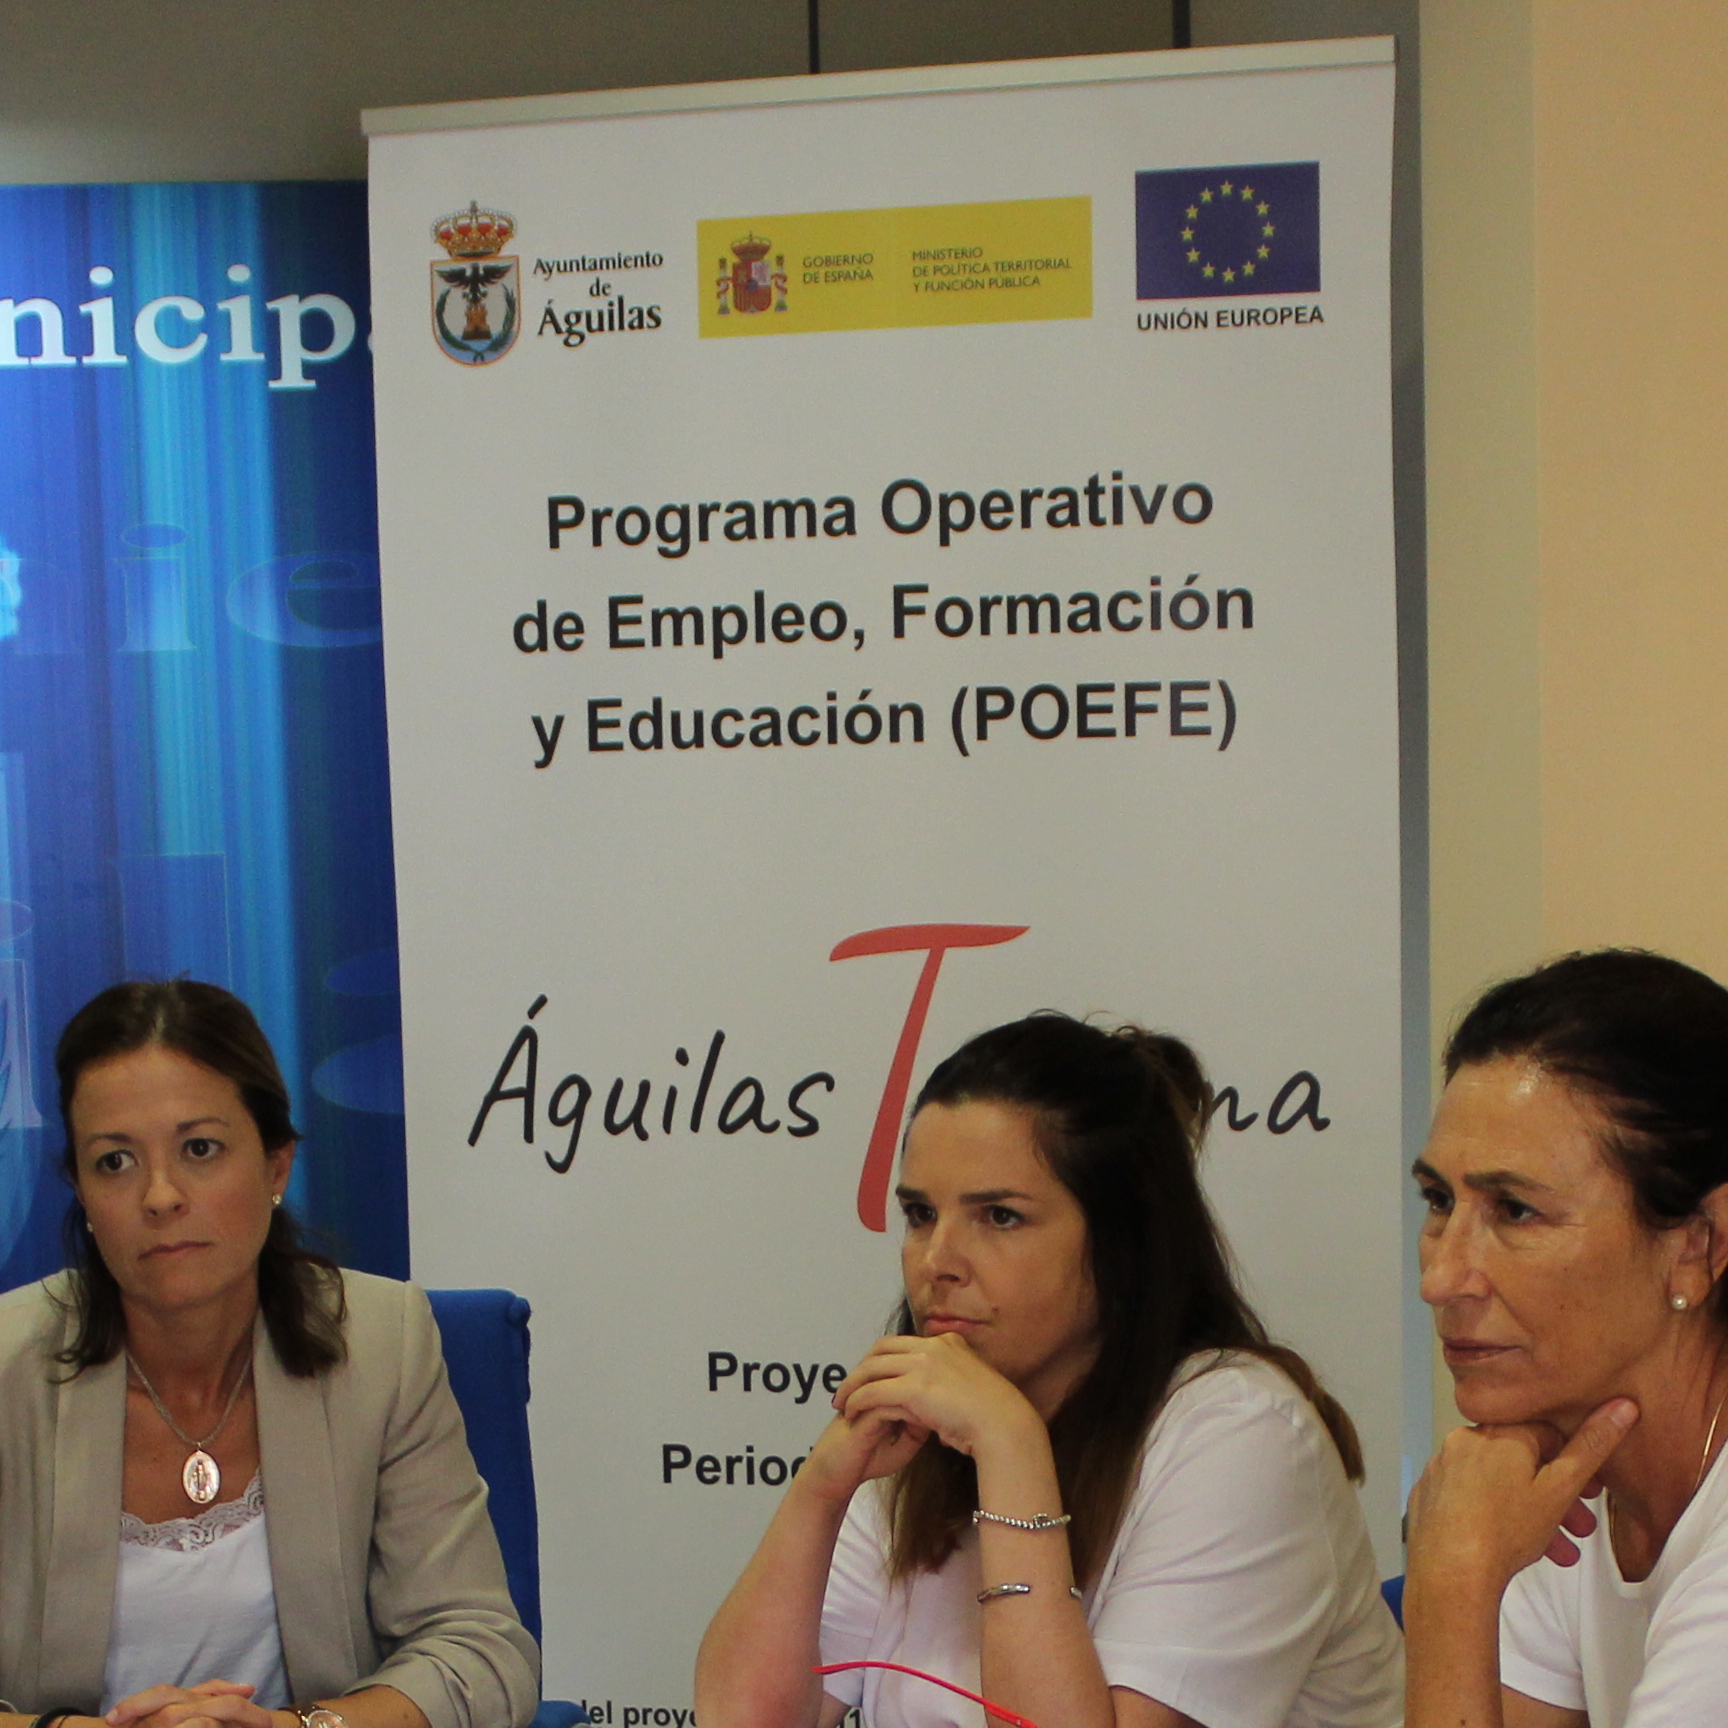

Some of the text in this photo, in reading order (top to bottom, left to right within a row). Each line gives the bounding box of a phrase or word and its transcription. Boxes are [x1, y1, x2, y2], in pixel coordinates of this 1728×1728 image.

[533, 251, 663, 280] Ayuntamiento
[803, 253, 874, 268] GOBIERNO
[912, 247, 983, 261] MINISTERIO
[803, 267, 874, 284] DE ESPAÑA
[912, 258, 1072, 278] DE POLÍTICA TERRITORIAL
[589, 276, 612, 297] de
[913, 275, 1041, 293] Y FUNCIÓN PÚBLICA
[537, 295, 662, 347] Águilas
[1137, 304, 1324, 330] UNIÓN EUROPEA
[547, 471, 1215, 559] Programa Operativo
[513, 575, 1256, 661] de Empleo, Formación
[531, 680, 1239, 770] y Educación (POEFE)
[468, 993, 837, 1175] Águilas
[708, 1351, 848, 1405] Proye
